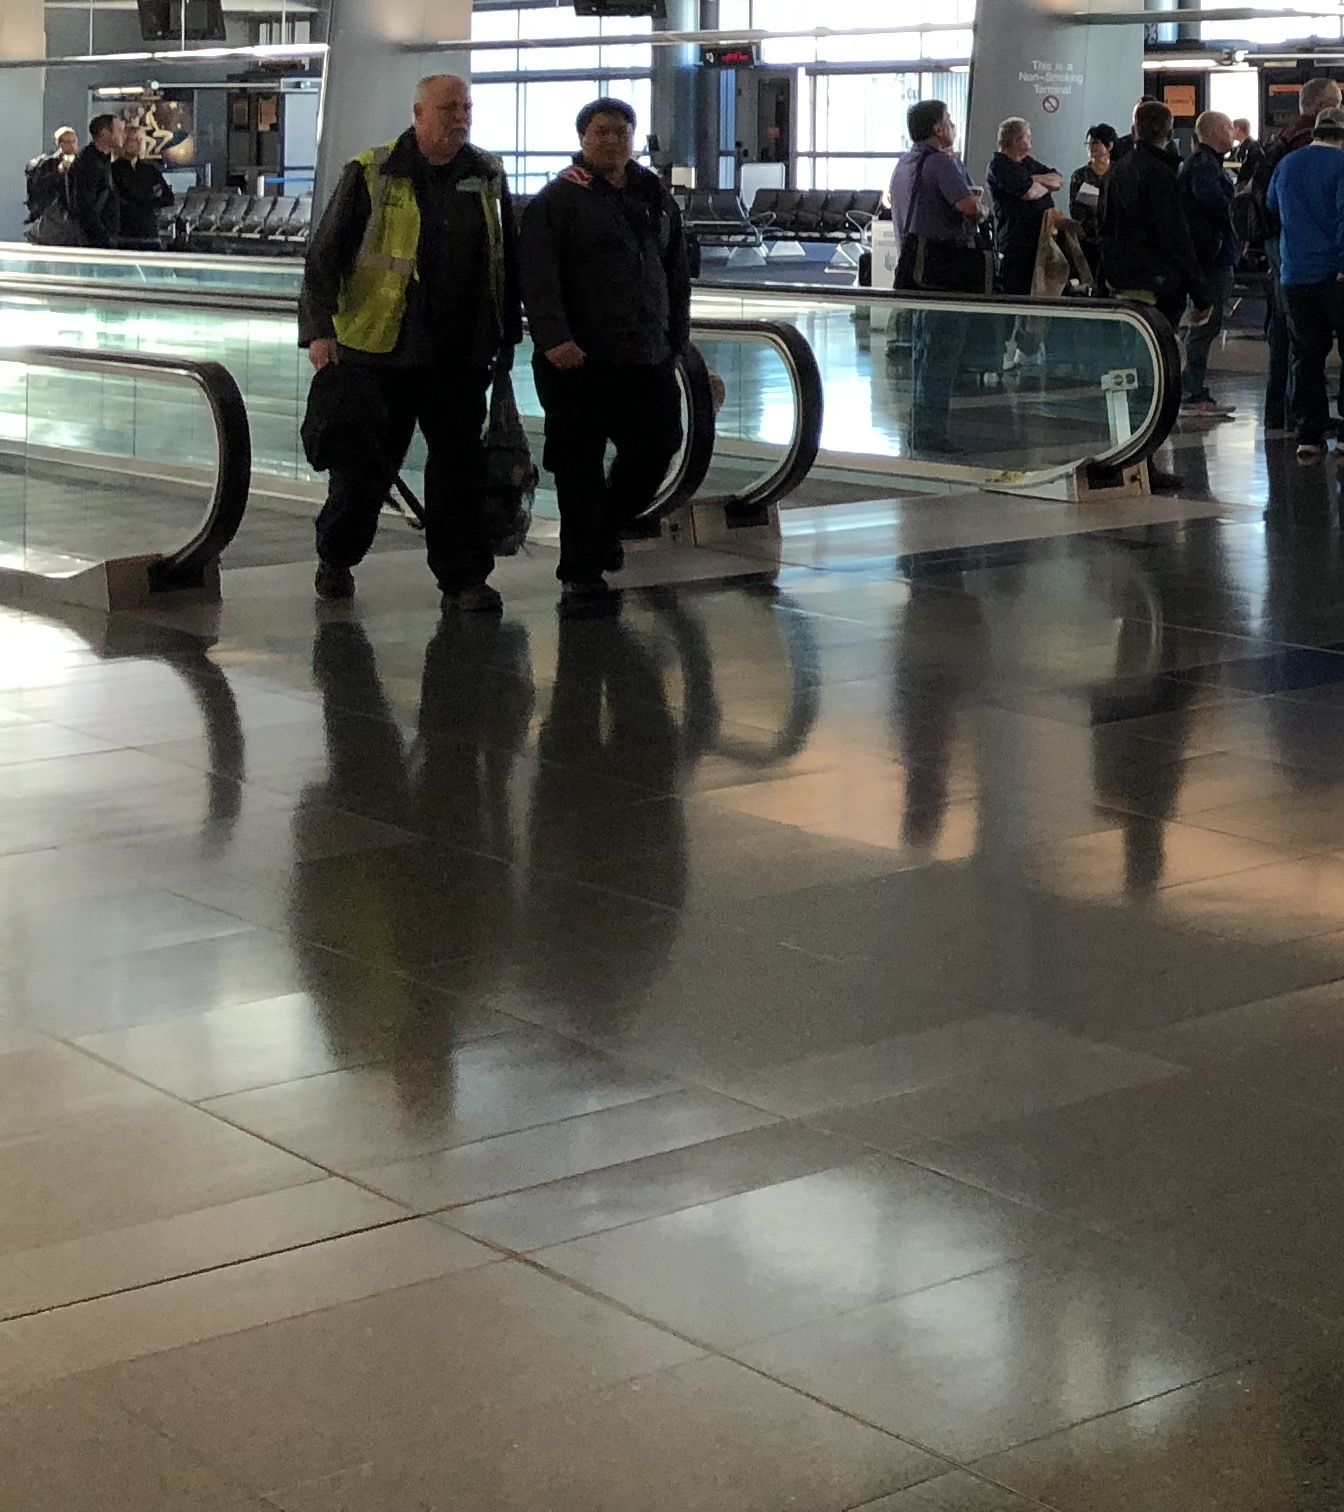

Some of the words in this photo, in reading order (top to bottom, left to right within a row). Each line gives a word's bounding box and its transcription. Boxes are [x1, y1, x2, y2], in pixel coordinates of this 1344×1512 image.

[1031, 59, 1052, 70] This
[1055, 61, 1063, 70] is
[1066, 63, 1074, 72] a
[1018, 71, 1084, 85] Non-Smoking
[1033, 84, 1071, 94] Terminal
